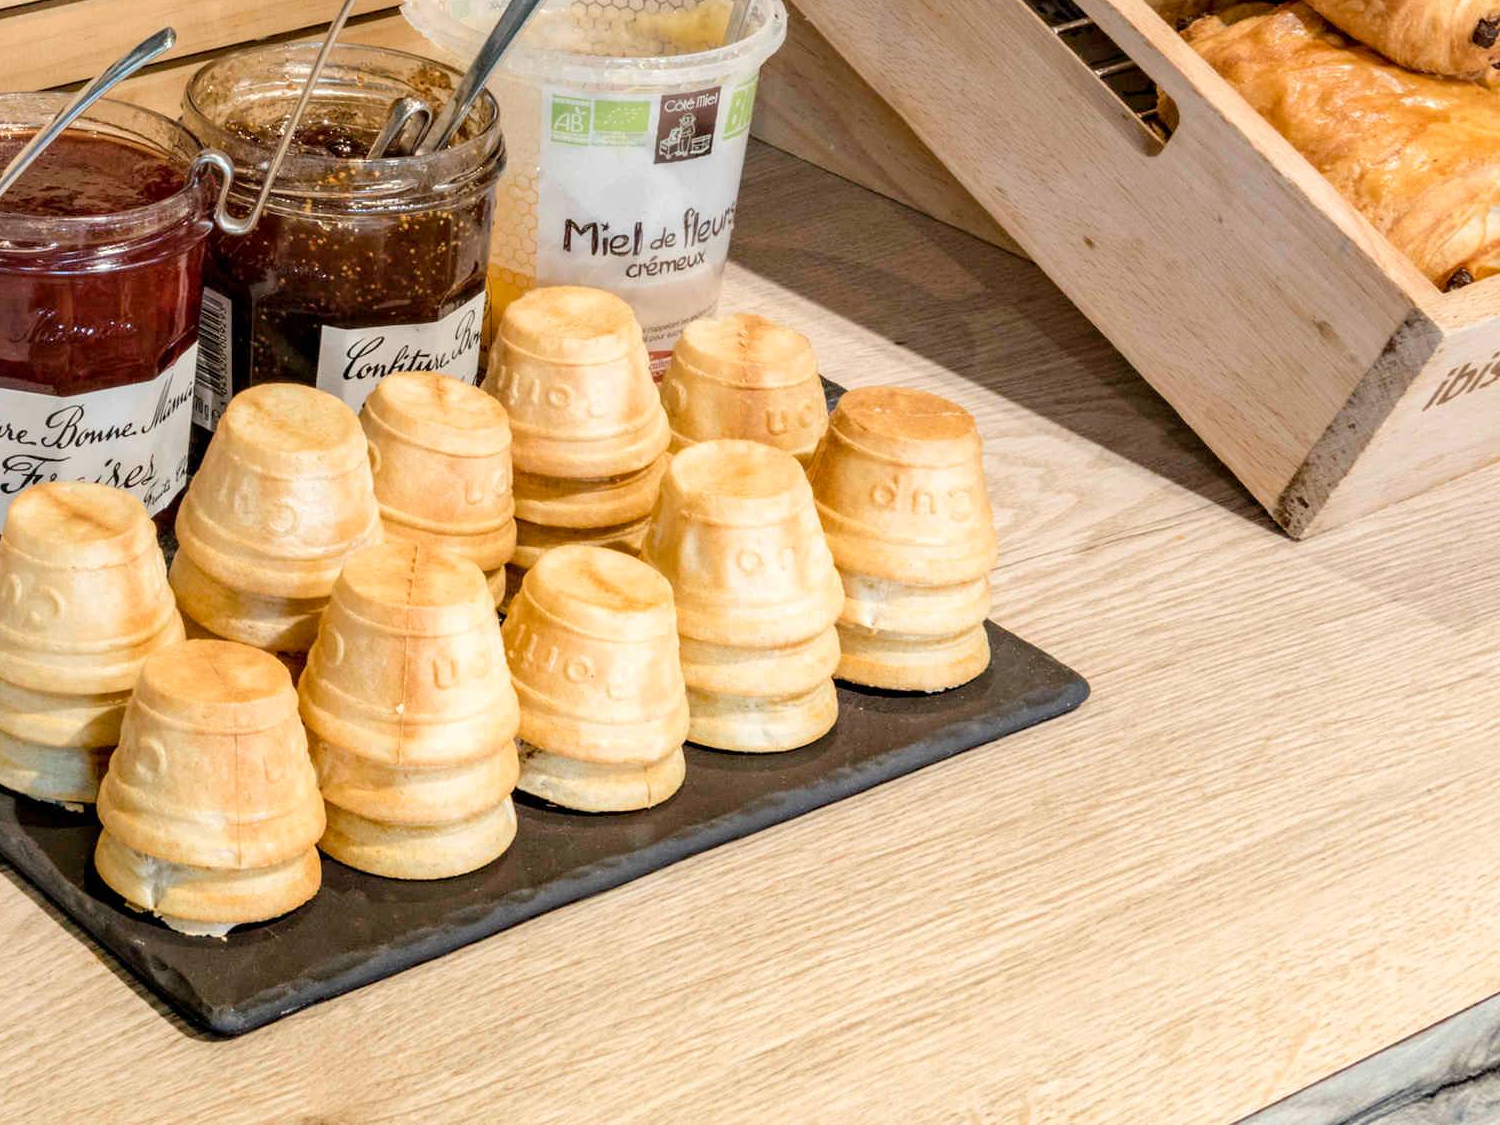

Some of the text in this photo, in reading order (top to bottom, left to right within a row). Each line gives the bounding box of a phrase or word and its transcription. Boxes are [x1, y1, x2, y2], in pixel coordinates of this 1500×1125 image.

[563, 218, 642, 256] Miel
[650, 227, 676, 250] de
[626, 249, 706, 278] crémeux
[41, 403, 137, 449] Bonne
